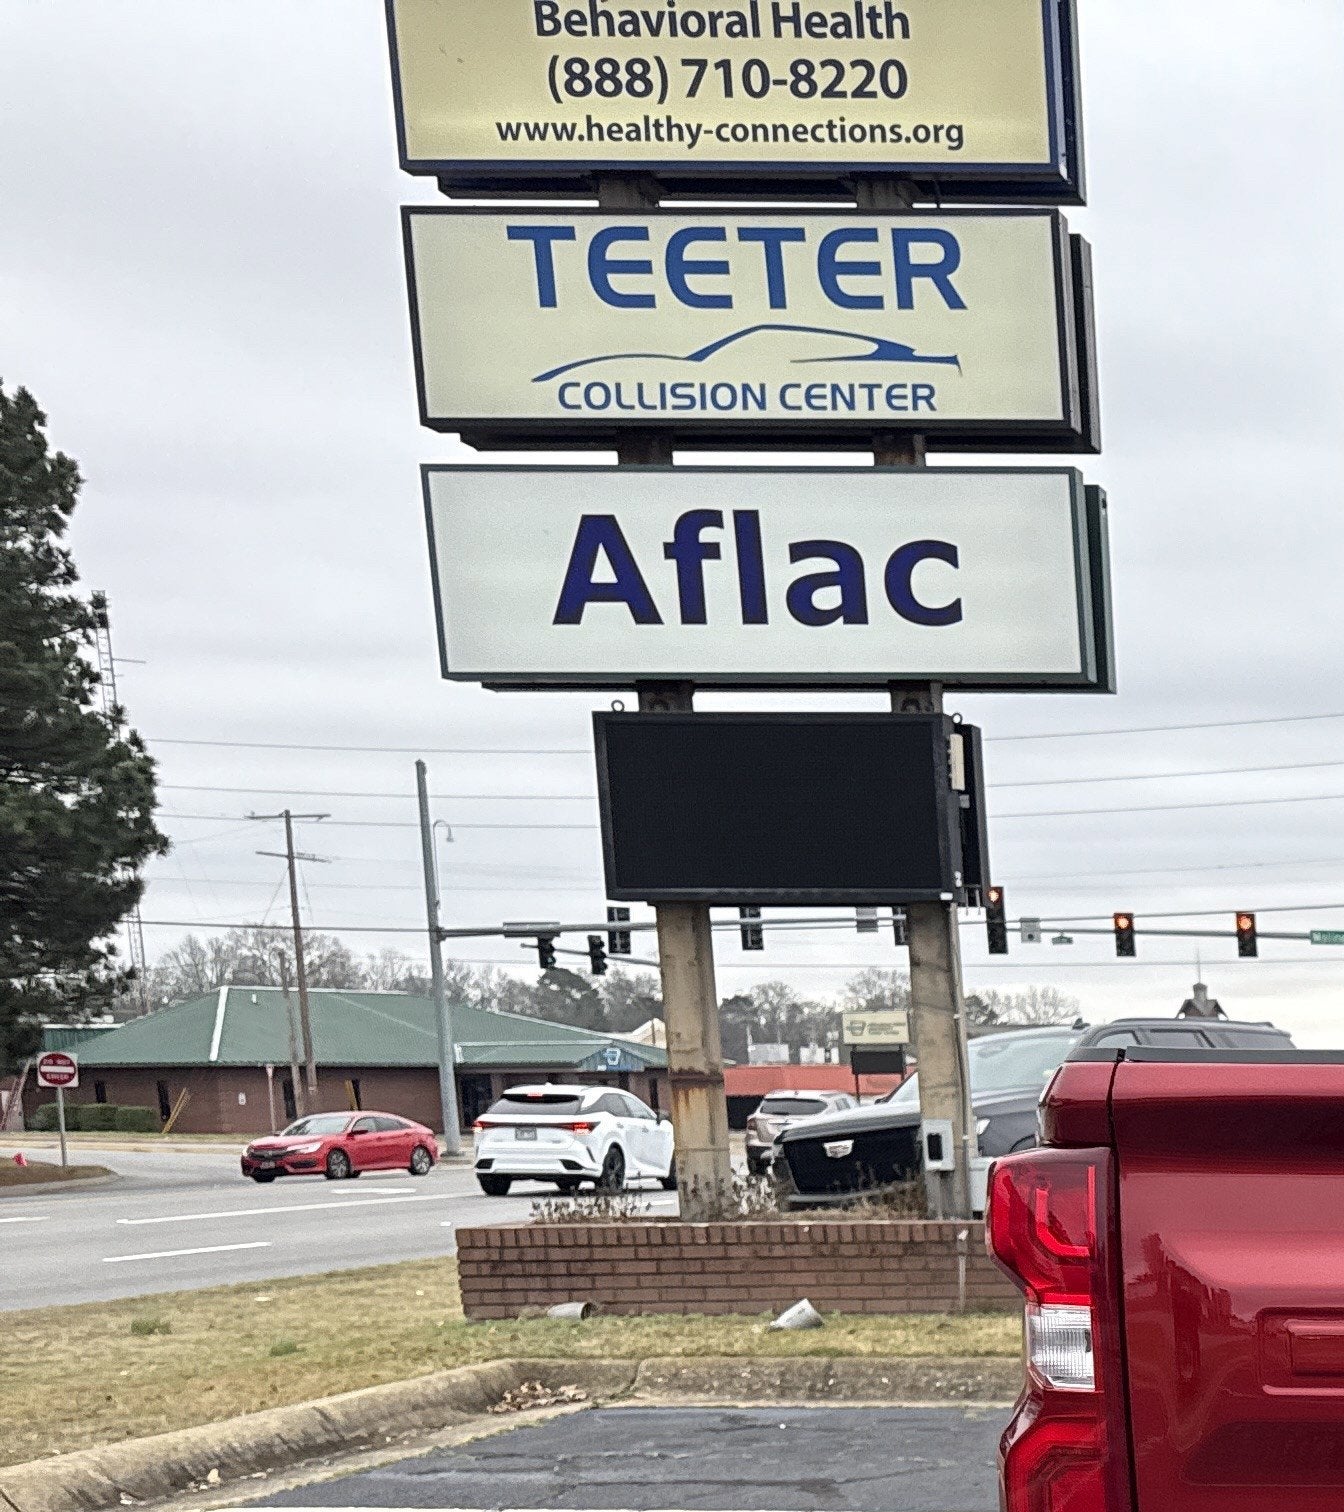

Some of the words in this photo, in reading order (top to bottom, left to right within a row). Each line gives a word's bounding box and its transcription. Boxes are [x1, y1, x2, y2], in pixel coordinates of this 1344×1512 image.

[535, 0, 761, 39] Behavioral
[772, 0, 911, 40] Health
[548, 54, 669, 105] (888)
[681, 57, 909, 100] 710-8220
[495, 114, 965, 151] www.healthy-connections.org
[505, 224, 969, 311] TEETER
[557, 381, 768, 412] COLLISION
[778, 382, 938, 412] CENTER
[551, 508, 964, 627] Aflac
